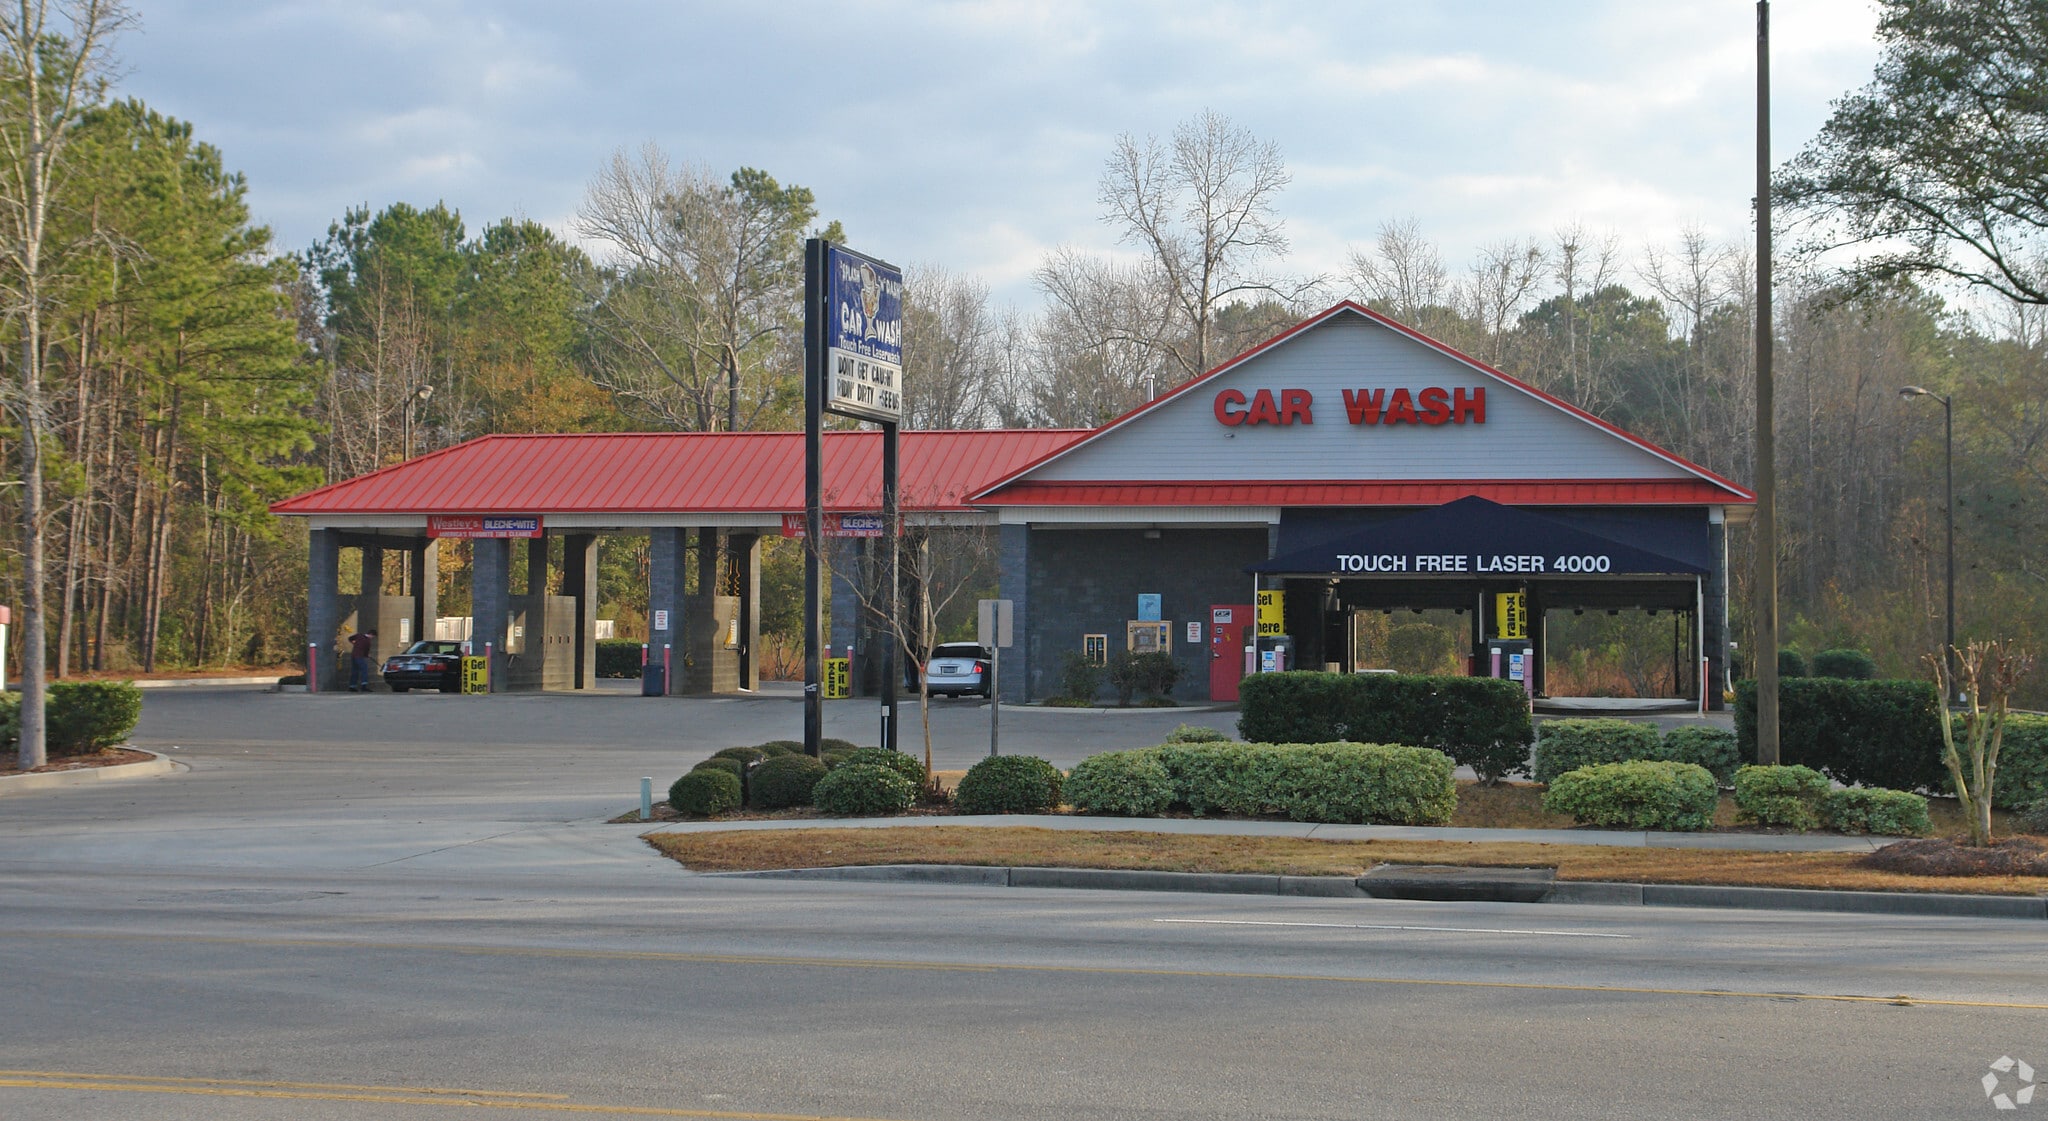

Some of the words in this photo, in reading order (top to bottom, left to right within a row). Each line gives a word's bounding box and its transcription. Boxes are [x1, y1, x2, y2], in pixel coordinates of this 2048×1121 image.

[841, 301, 862, 336] CAR
[875, 318, 901, 347] WASH
[839, 335, 856, 351] Touch
[858, 340, 871, 355] Free
[858, 361, 868, 380] GET
[872, 365, 893, 387] CAUGHT
[857, 383, 875, 404] DIRTY
[1213, 388, 1314, 426] CAR
[1341, 387, 1486, 426] WASH
[432, 516, 479, 530] Westley's
[1336, 554, 1407, 572] TOUCH
[1415, 554, 1468, 572] FREE
[1476, 555, 1545, 572] LASER
[1553, 555, 1611, 573] 4000
[470, 671, 478, 681] it
[838, 672, 845, 683] it
